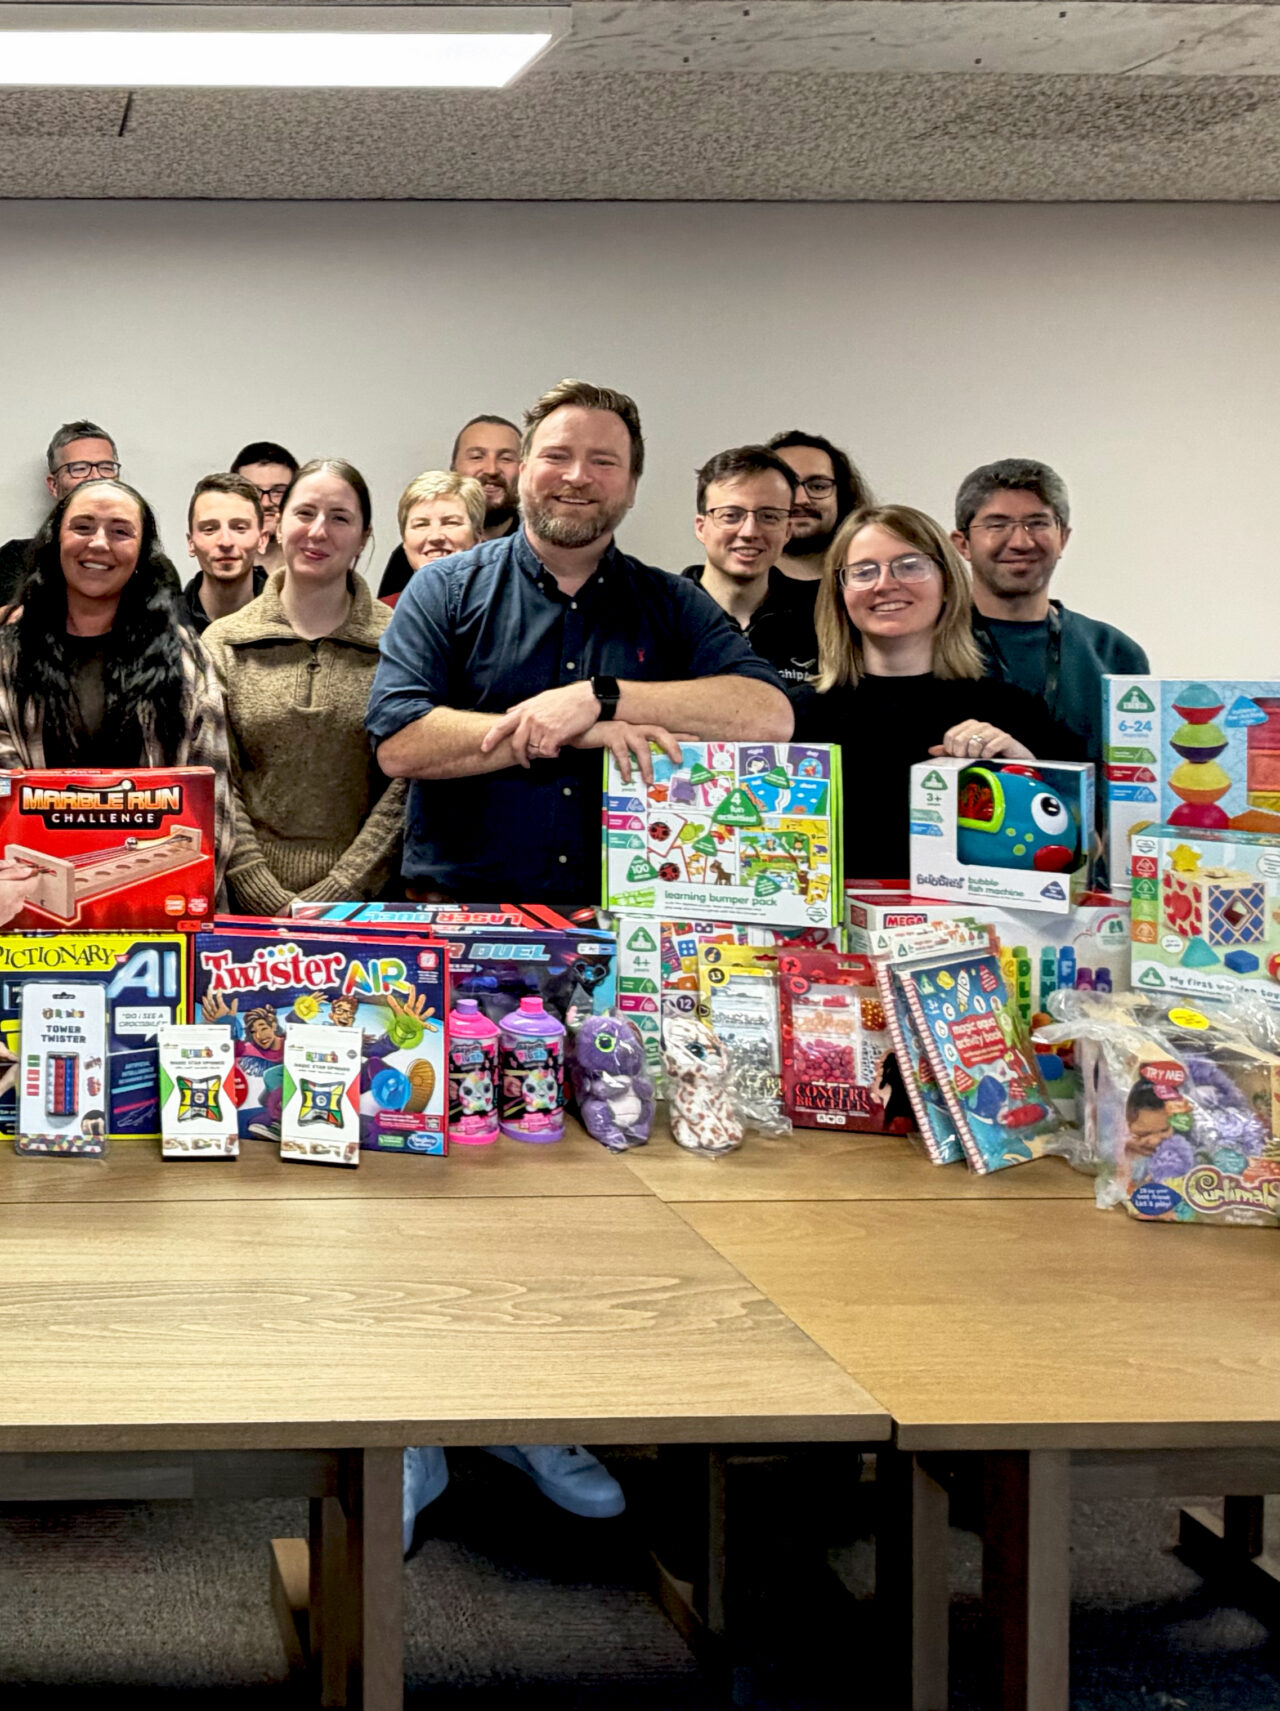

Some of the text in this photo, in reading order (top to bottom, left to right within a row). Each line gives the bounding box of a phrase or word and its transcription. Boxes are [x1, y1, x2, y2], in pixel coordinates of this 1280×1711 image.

[22, 787, 123, 810] MARBLE
[128, 787, 180, 810] RUN
[730, 793, 741, 805] 4
[926, 793, 942, 802] 3+
[729, 805, 745, 813] fun
[51, 813, 155, 823] CHALLENGE
[631, 864, 650, 874] 100
[968, 877, 999, 886] bubble
[985, 888, 1025, 897] machine
[665, 890, 706, 903] learning
[709, 892, 748, 905] bumper
[752, 896, 777, 908] pack
[436, 913, 522, 925] LASER
[887, 915, 924, 927] MEGA
[469, 943, 550, 961] DUEL
[632, 956, 650, 967] 4+
[106, 949, 177, 998] AI
[202, 946, 412, 994] Twister AIR
[678, 998, 693, 1009] 12
[46, 1025, 81, 1033] TOWER
[952, 1021, 976, 1035] magic
[40, 1035, 87, 1043] TWISTER
[956, 1028, 1002, 1049] activity book
